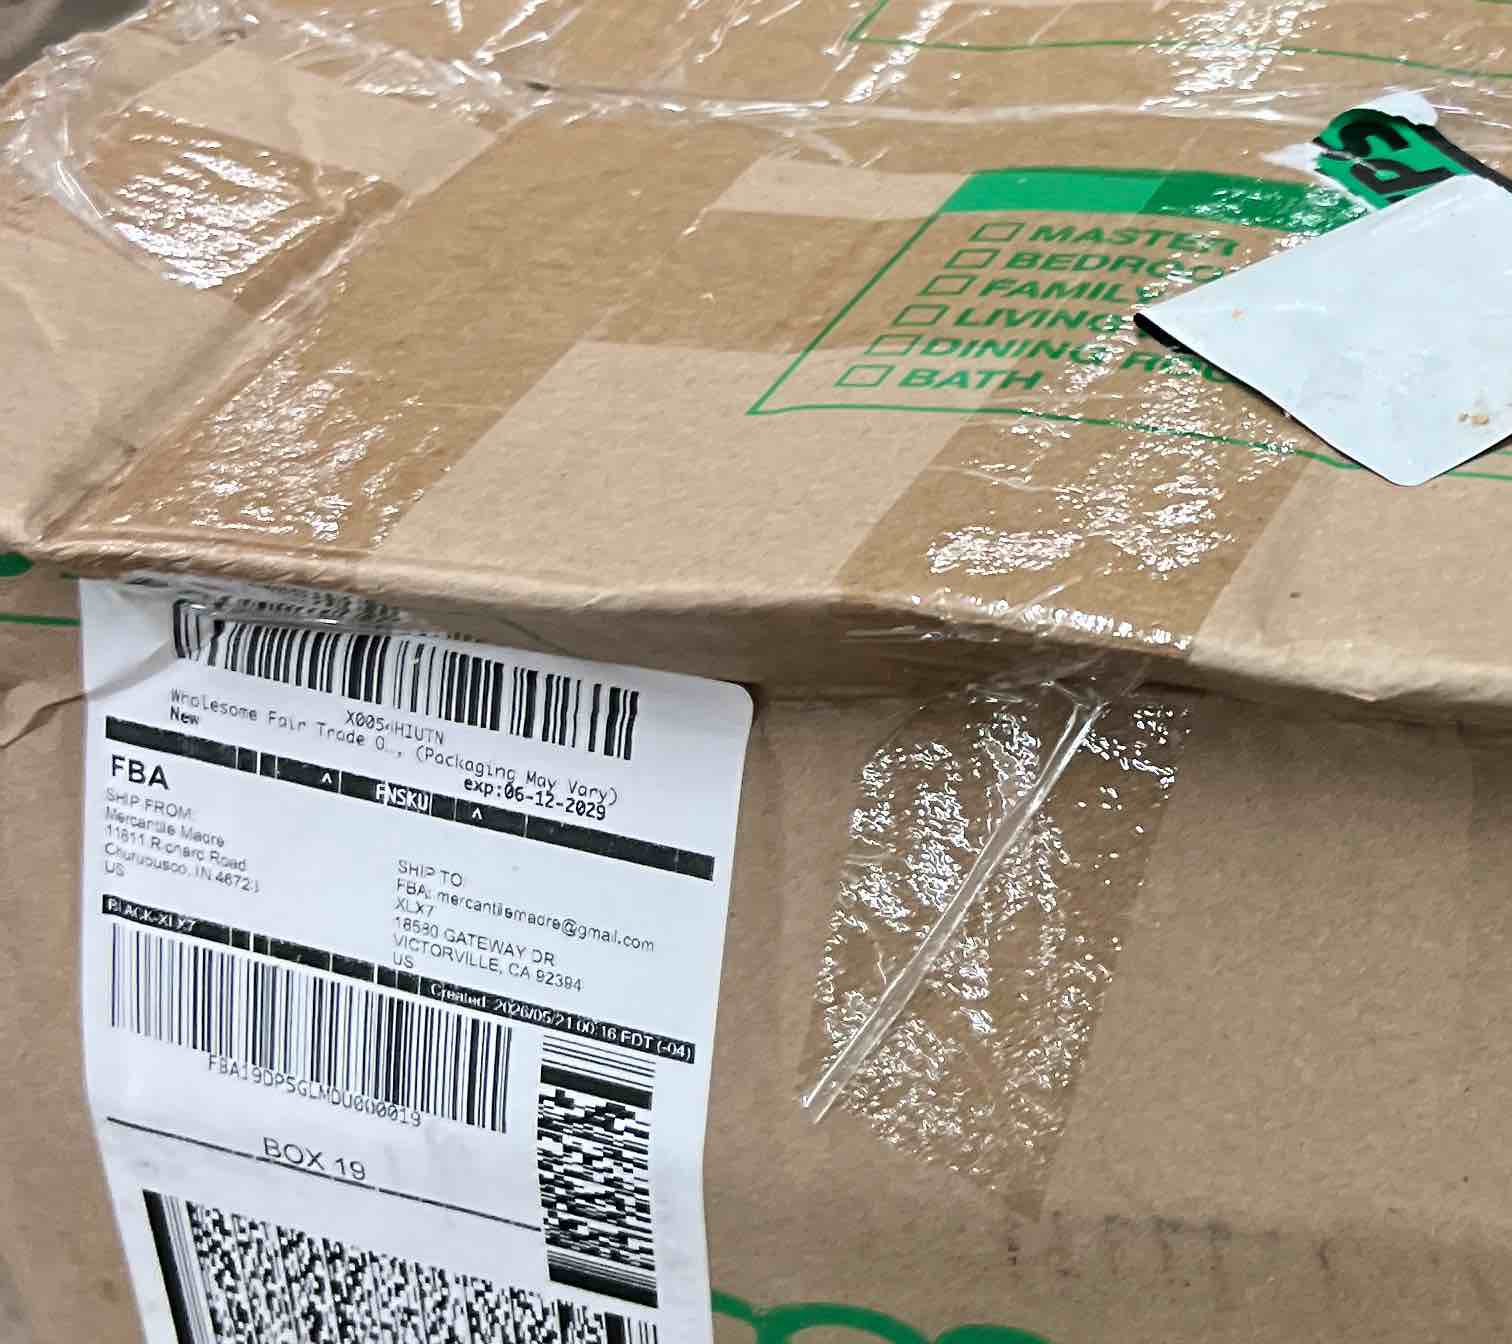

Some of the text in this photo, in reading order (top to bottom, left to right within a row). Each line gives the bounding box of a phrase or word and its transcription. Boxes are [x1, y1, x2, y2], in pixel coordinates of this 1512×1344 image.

[1028, 223, 1240, 258] MASTER
[897, 367, 1046, 391] BATH
[168, 706, 200, 727] New
[110, 753, 170, 792] FBA
[266, 708, 308, 733] Fair
[315, 719, 367, 745] Trade
[525, 765, 560, 792] May
[567, 773, 620, 807] Vary)
[105, 788, 142, 811] SHIP
[375, 781, 431, 813] FNSKU
[463, 775, 607, 821] exp:06-12-2029
[396, 859, 433, 882] SHIP
[394, 897, 435, 918] XLX7
[391, 950, 417, 973] US
[393, 934, 505, 978] VICTORVILLE,
[507, 961, 533, 982] CA
[444, 924, 529, 959] GATEWAY
[531, 948, 556, 969] DR
[262, 1135, 368, 1182] BOX 19
